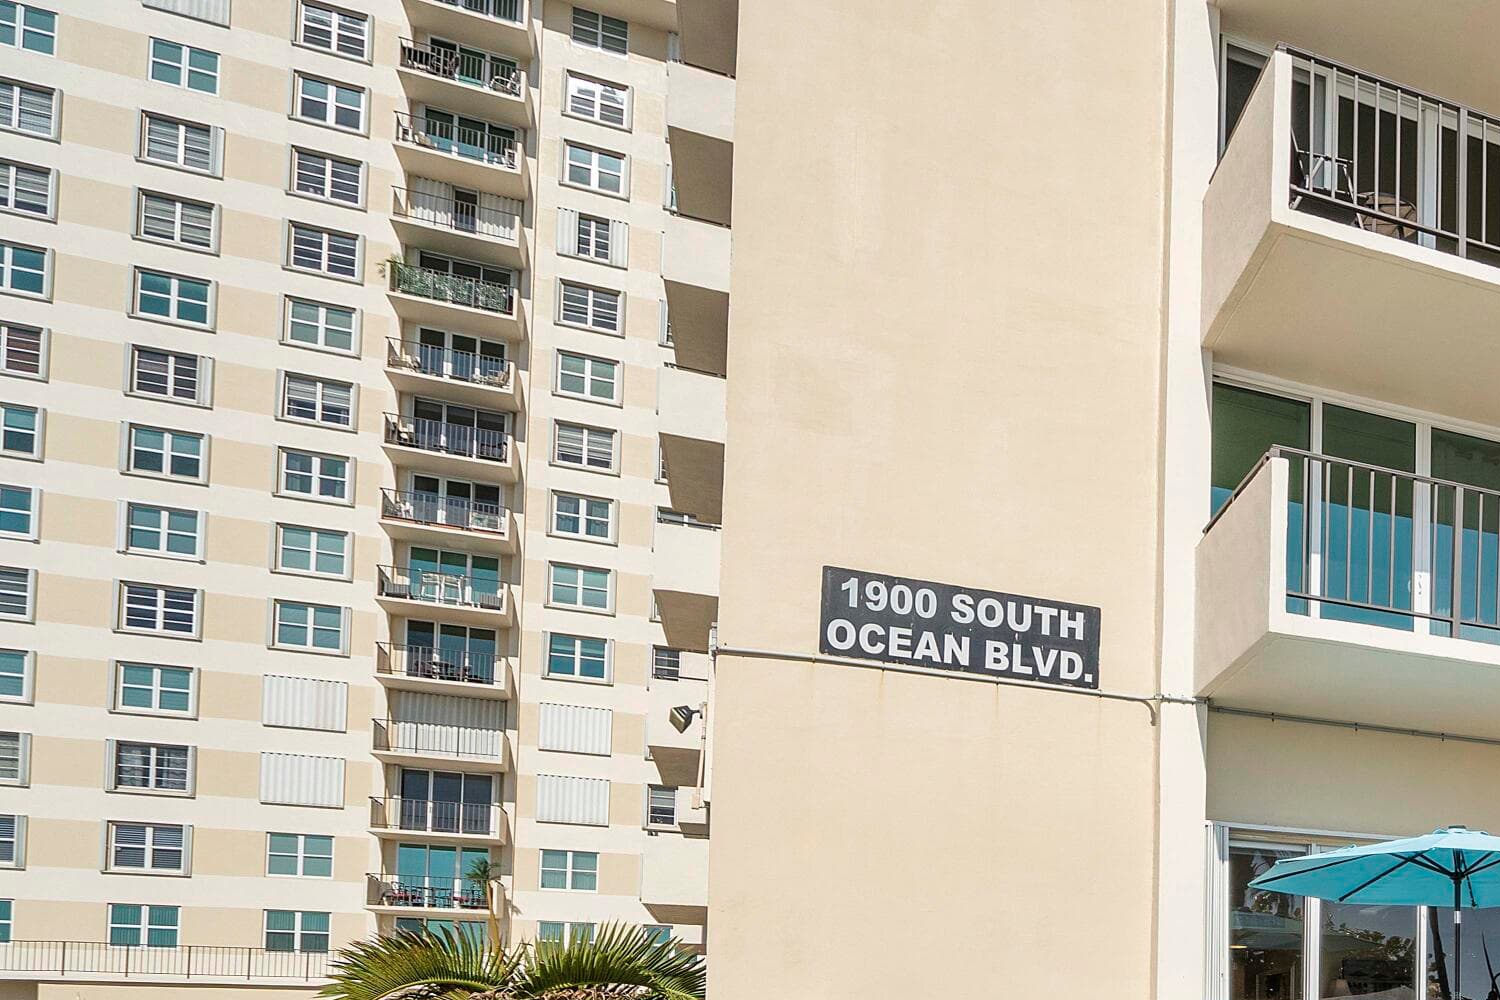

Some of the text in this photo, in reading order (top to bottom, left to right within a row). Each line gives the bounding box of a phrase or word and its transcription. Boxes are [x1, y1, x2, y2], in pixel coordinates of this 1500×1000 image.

[841, 577, 1086, 641] 1900 SOUTH
[826, 618, 1093, 683] OCEAN BLVD.
